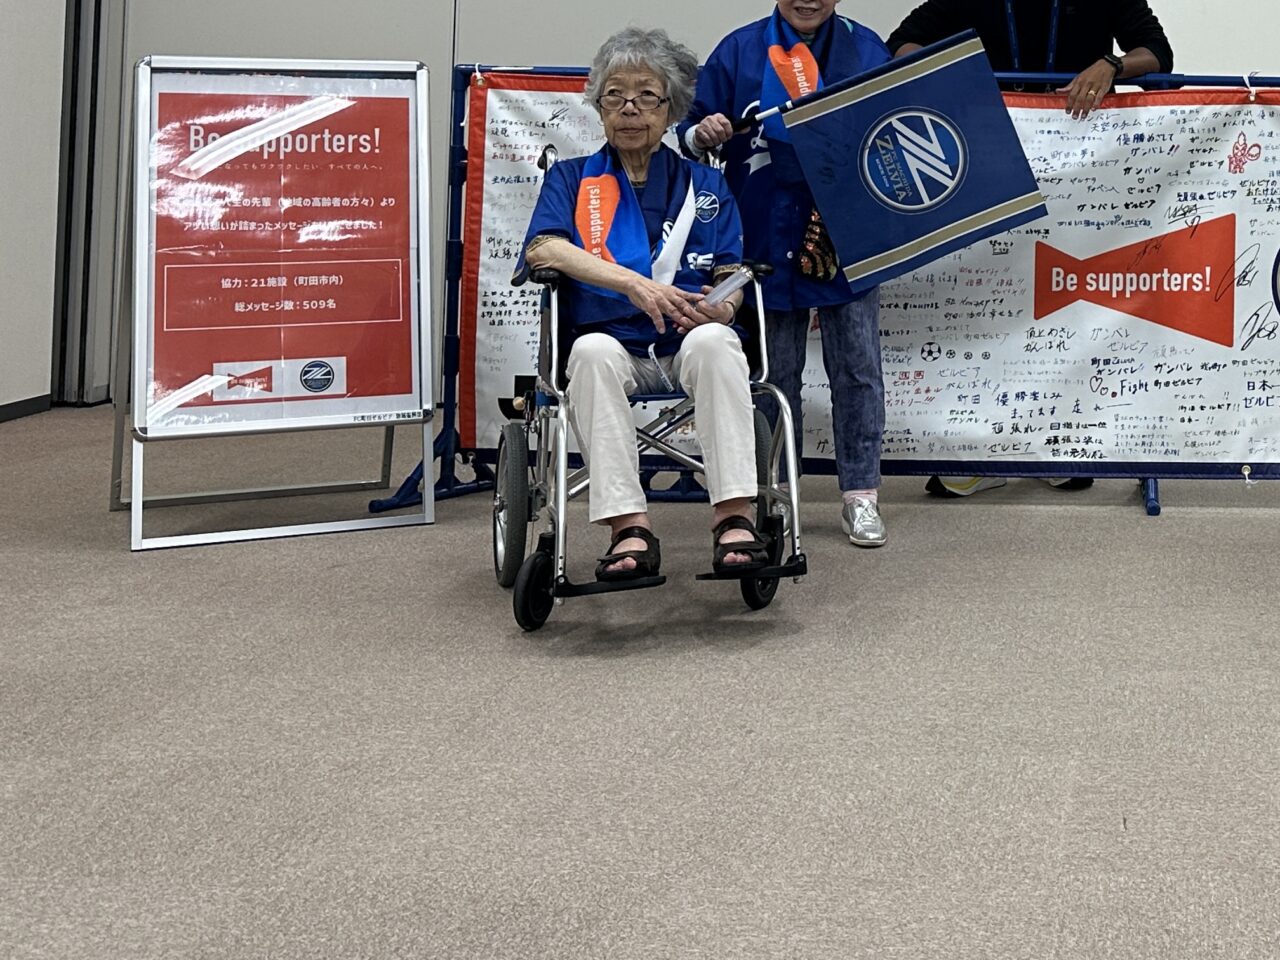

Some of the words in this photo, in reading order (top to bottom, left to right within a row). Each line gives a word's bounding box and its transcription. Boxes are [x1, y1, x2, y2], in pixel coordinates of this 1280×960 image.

[236, 127, 382, 160] upporters!
[875, 134, 907, 202] ZELVIA
[586, 185, 605, 244] supporters!
[221, 274, 344, 289] 協力：21施設（町田市内）
[1051, 266, 1078, 291] Be
[1085, 266, 1212, 298] supporters!
[234, 298, 337, 313] 総メッセージ数：509名
[1120, 379, 1149, 397] Fight
